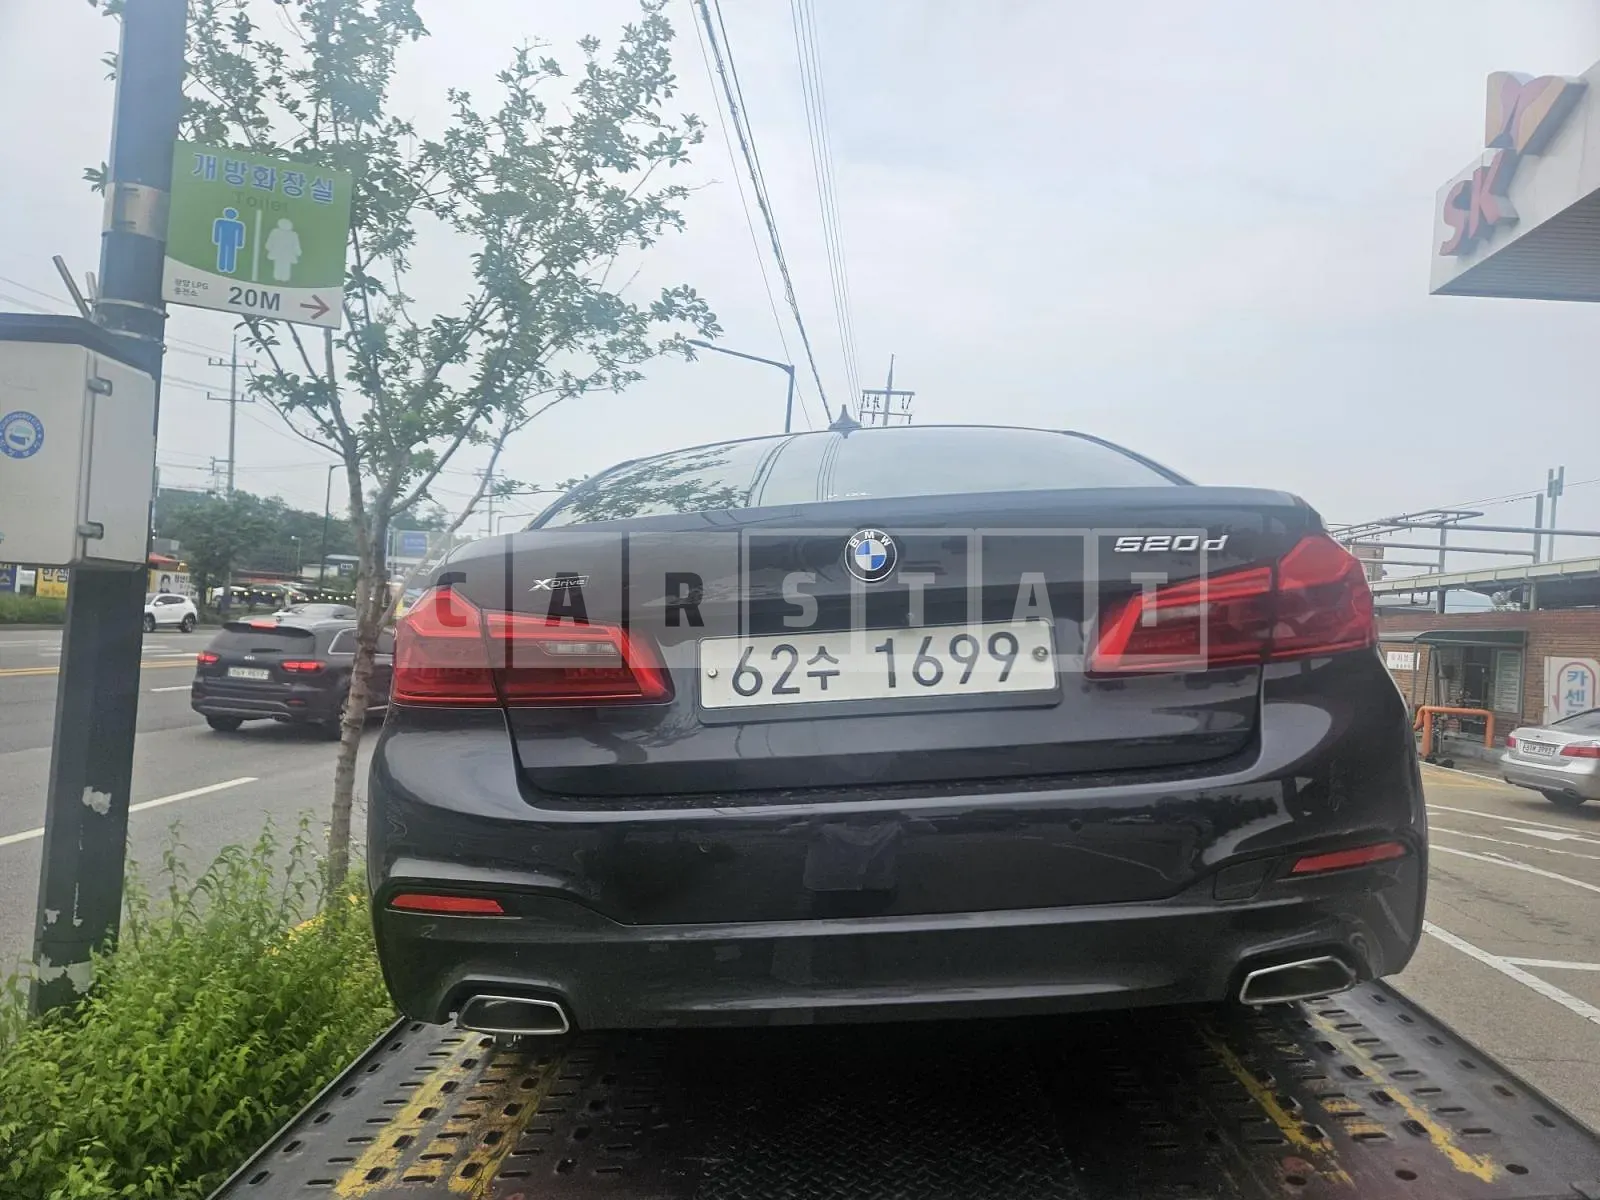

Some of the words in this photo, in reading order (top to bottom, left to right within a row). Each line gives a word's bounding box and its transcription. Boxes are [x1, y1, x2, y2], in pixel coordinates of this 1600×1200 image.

[192, 153, 334, 205] 개방화장실
[232, 191, 289, 212] Toilet
[1439, 150, 1508, 256] SK
[191, 280, 209, 290] LPG
[228, 286, 281, 311] 20M
[849, 531, 891, 548] BMW
[1113, 534, 1229, 553] 520d
[731, 643, 841, 697] 62수
[875, 631, 1020, 689] 1699
[1565, 670, 1589, 716] 카센
